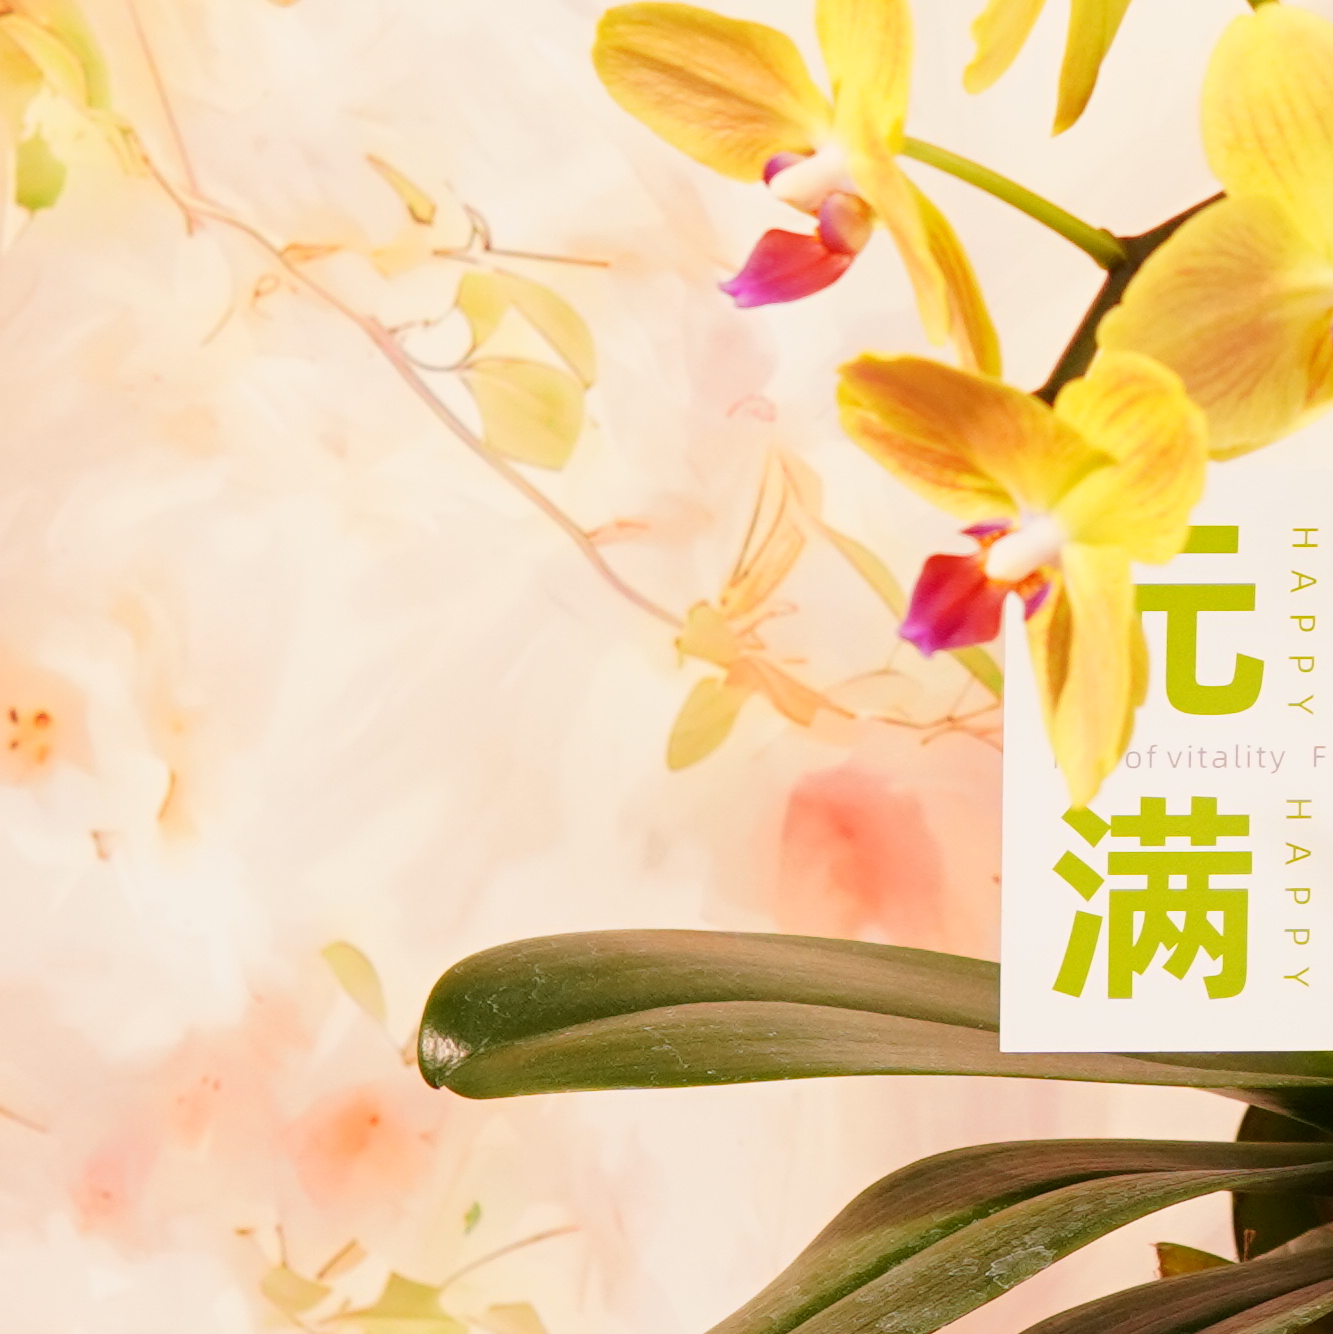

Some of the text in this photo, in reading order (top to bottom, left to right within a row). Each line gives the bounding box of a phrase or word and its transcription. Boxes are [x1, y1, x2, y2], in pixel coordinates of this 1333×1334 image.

[1287, 527, 1319, 715] HAPPY
[1125, 745, 1158, 769] of
[1167, 744, 1286, 774] vitality
[1283, 798, 1313, 987] HAPPY
